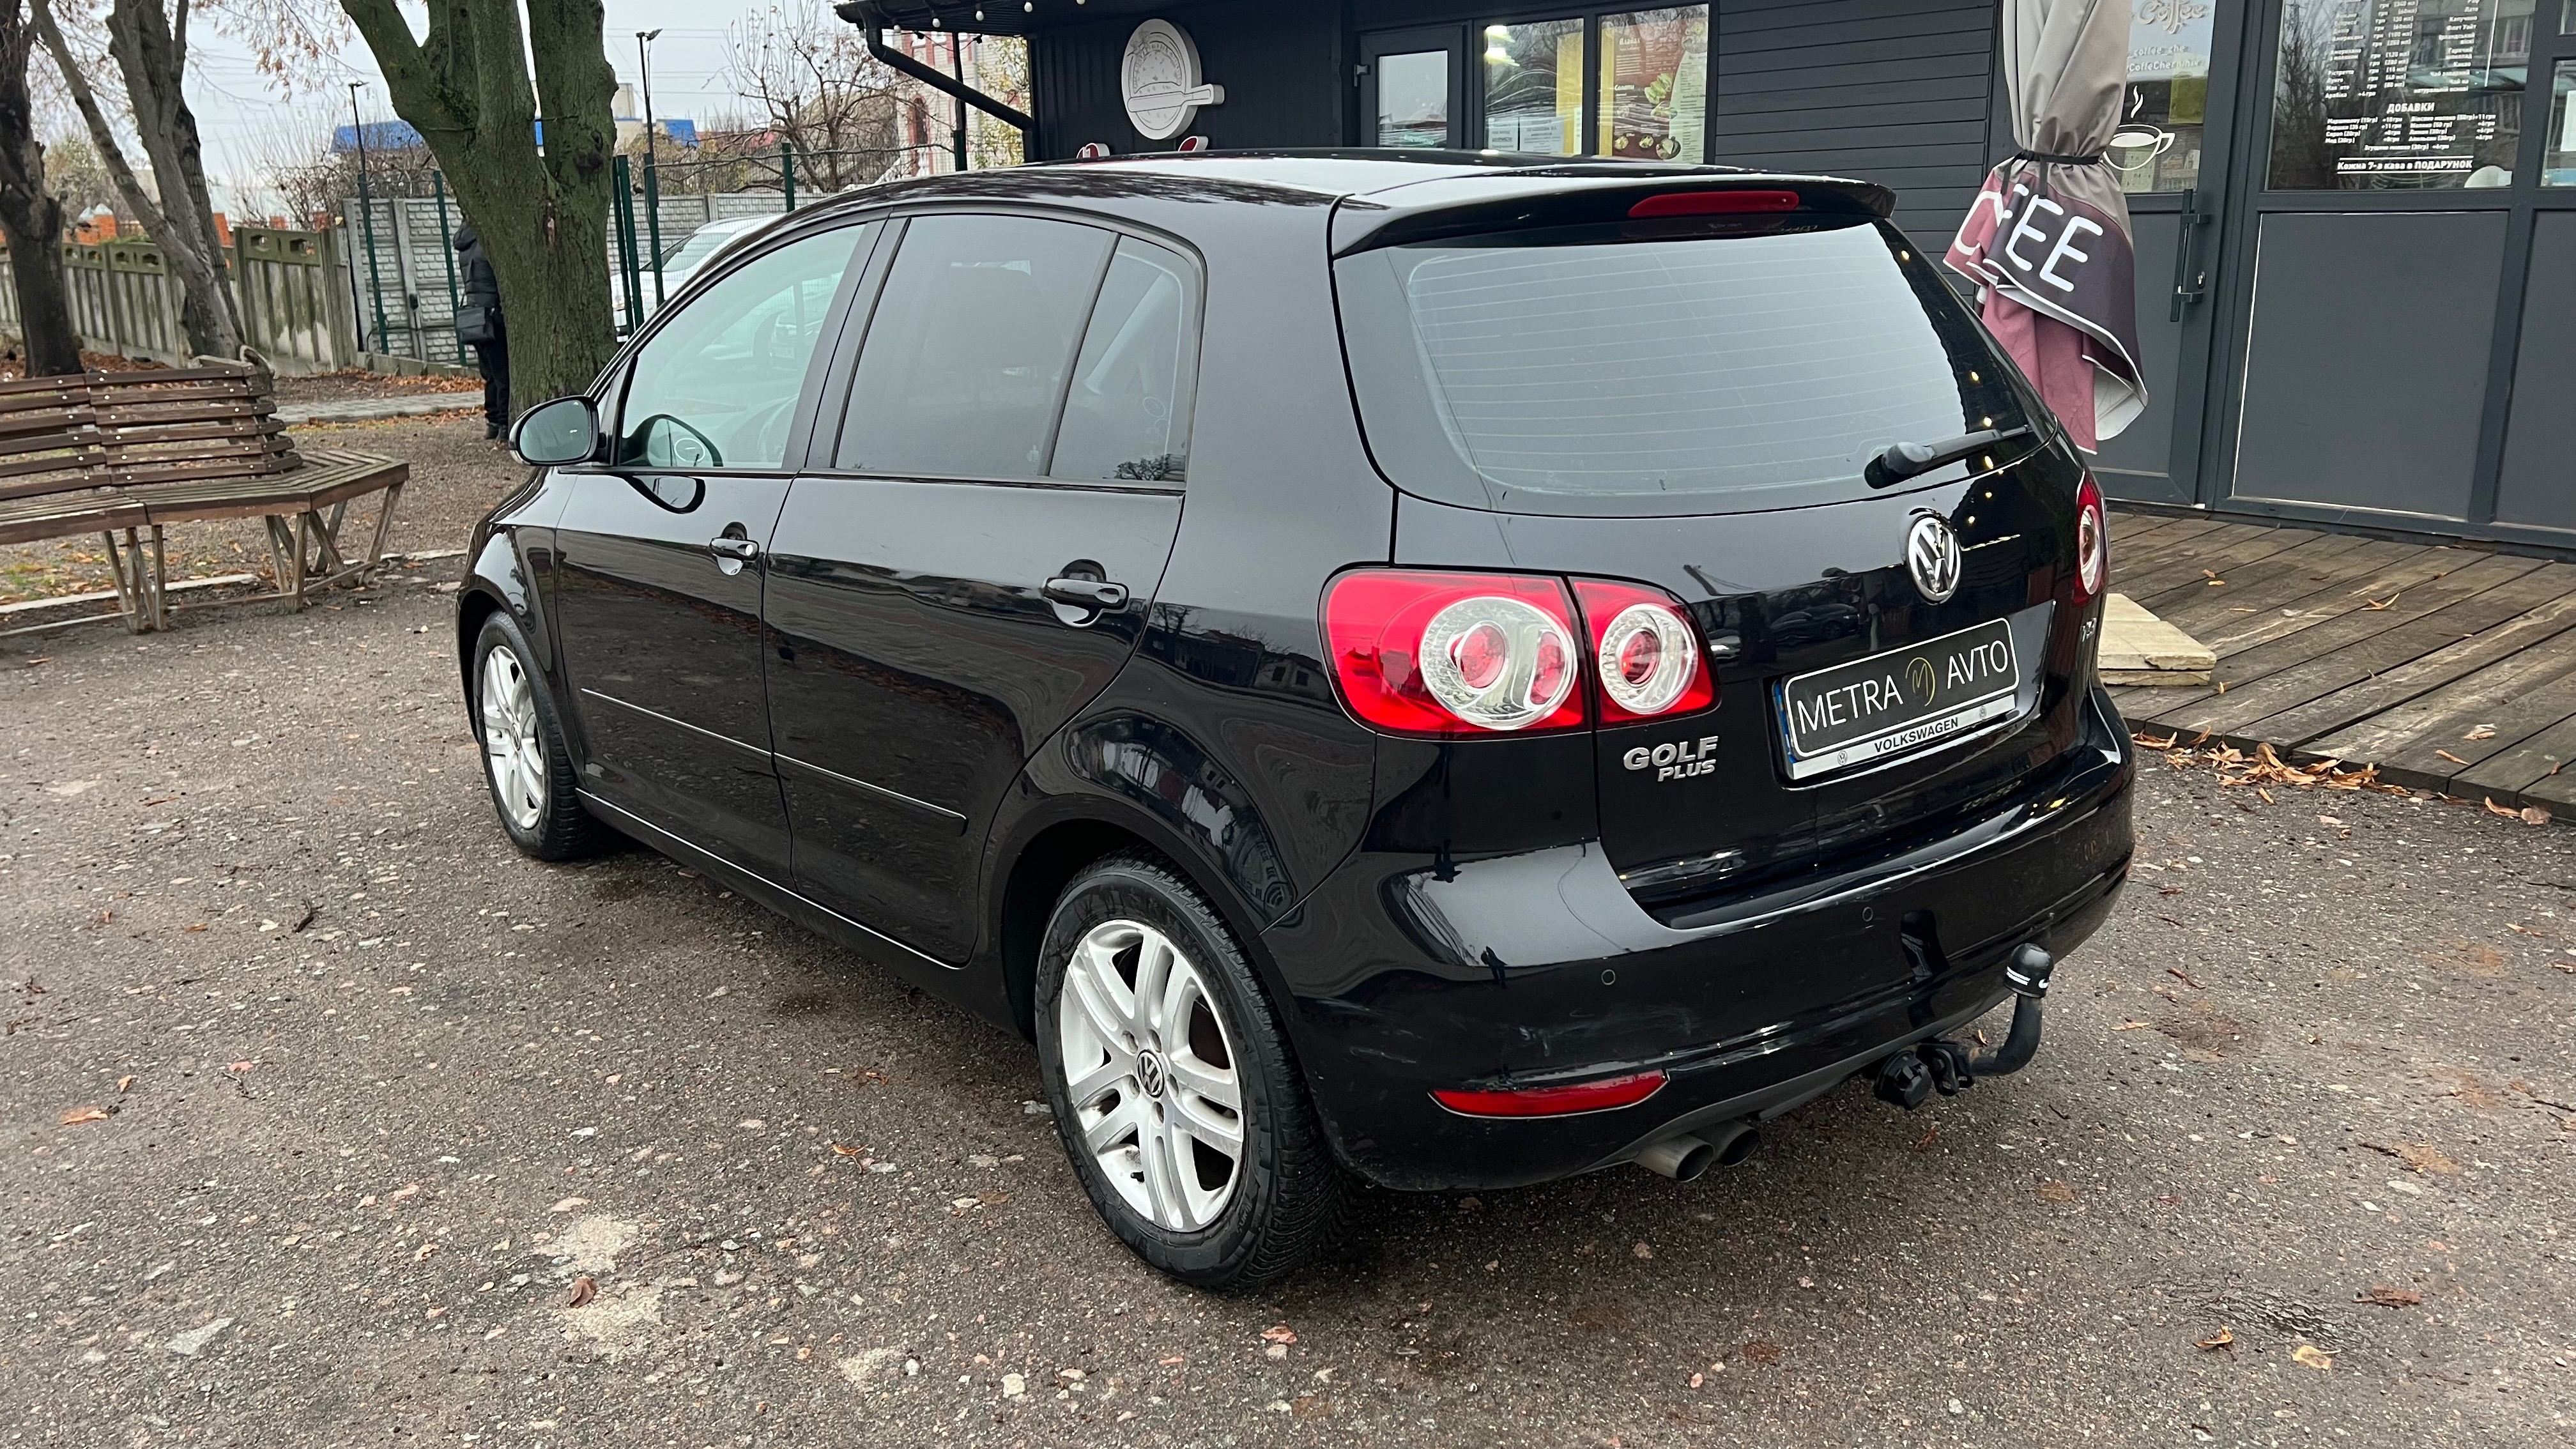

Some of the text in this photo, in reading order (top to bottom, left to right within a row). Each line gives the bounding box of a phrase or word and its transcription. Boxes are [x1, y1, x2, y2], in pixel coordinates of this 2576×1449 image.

[2386, 102, 2435, 114] ДОБАВКИ
[2337, 162, 2366, 171] Кожна
[2384, 162, 2405, 170] кава
[2414, 160, 2473, 171] ПОДАРУНОК
[1797, 675, 1903, 735] METRA
[1947, 640, 2009, 689] AVTO
[1874, 717, 1958, 753] VOLKSWAGEN
[1623, 735, 1719, 770] GOLF
[1657, 759, 1717, 782] PLUS
